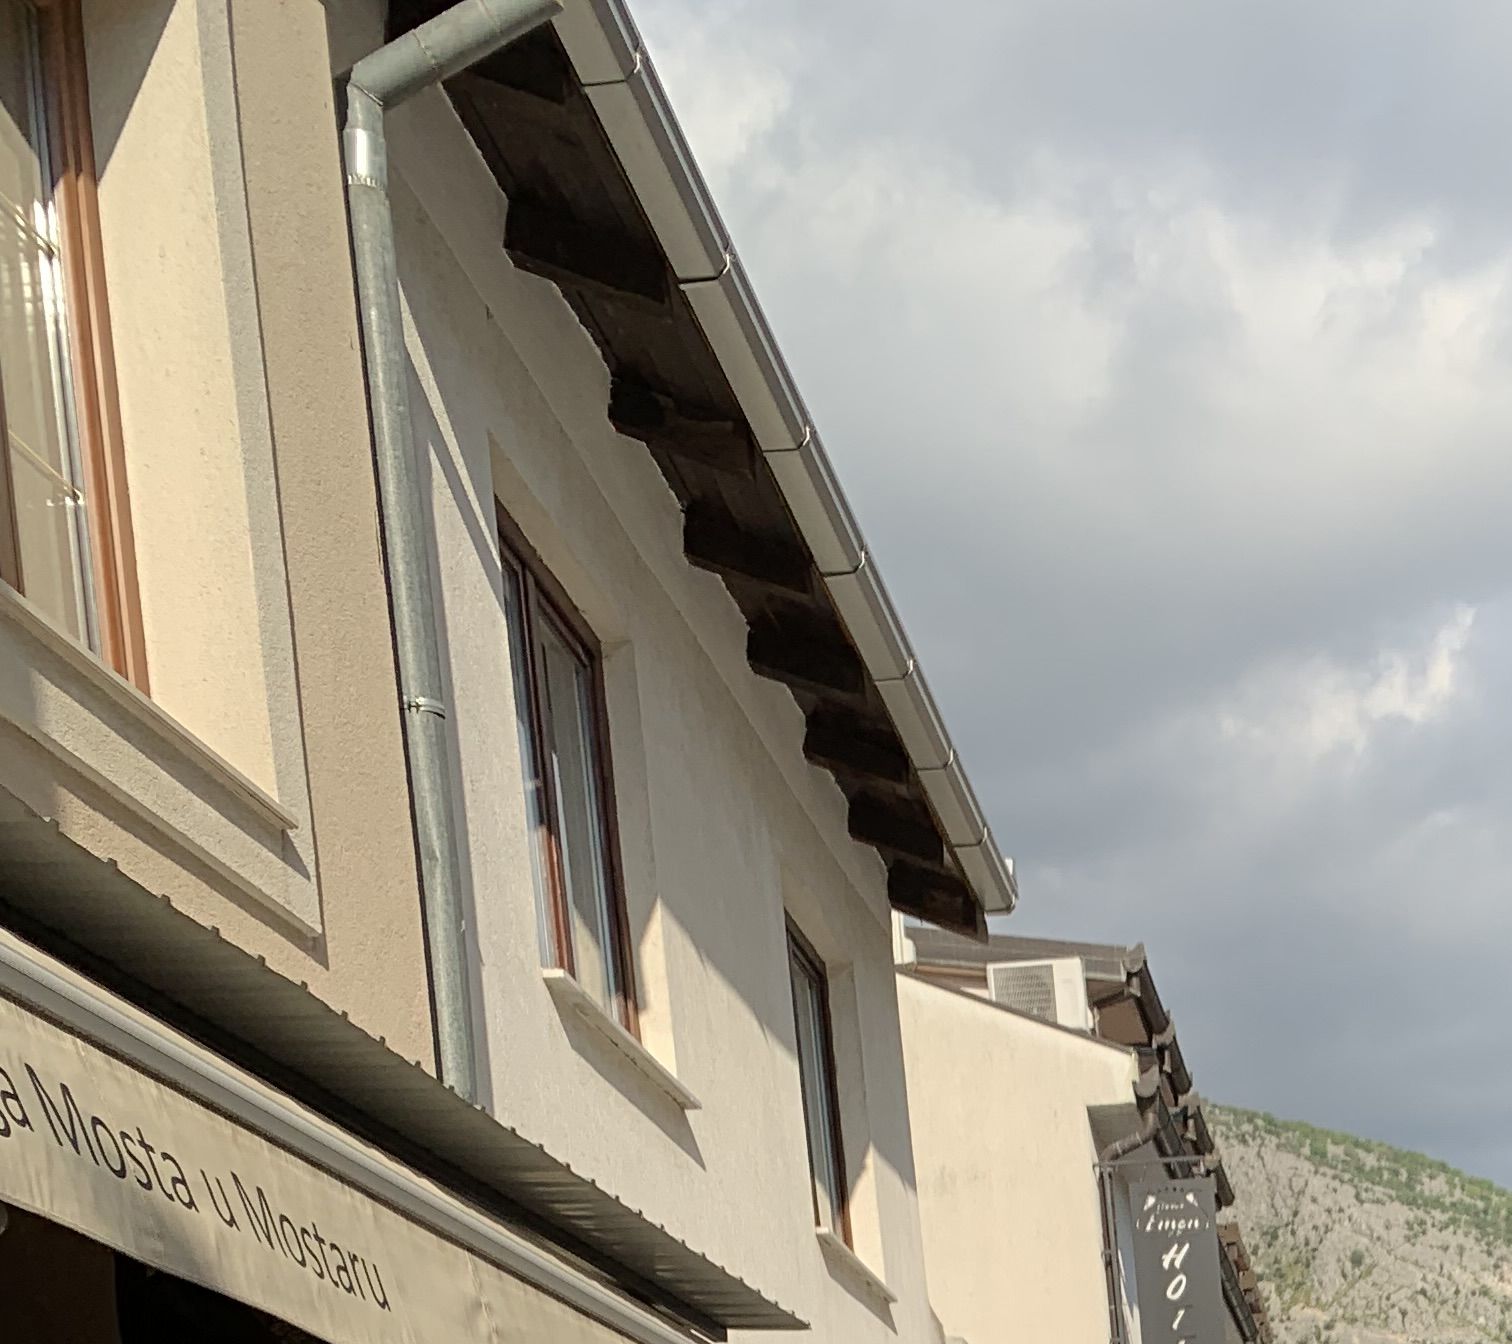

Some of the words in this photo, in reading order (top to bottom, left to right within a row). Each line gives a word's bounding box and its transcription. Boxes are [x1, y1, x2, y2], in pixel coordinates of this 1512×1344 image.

[24, 1062, 200, 1214] Mosta
[200, 1168, 241, 1232] u
[230, 1170, 392, 1313] Mostaru
